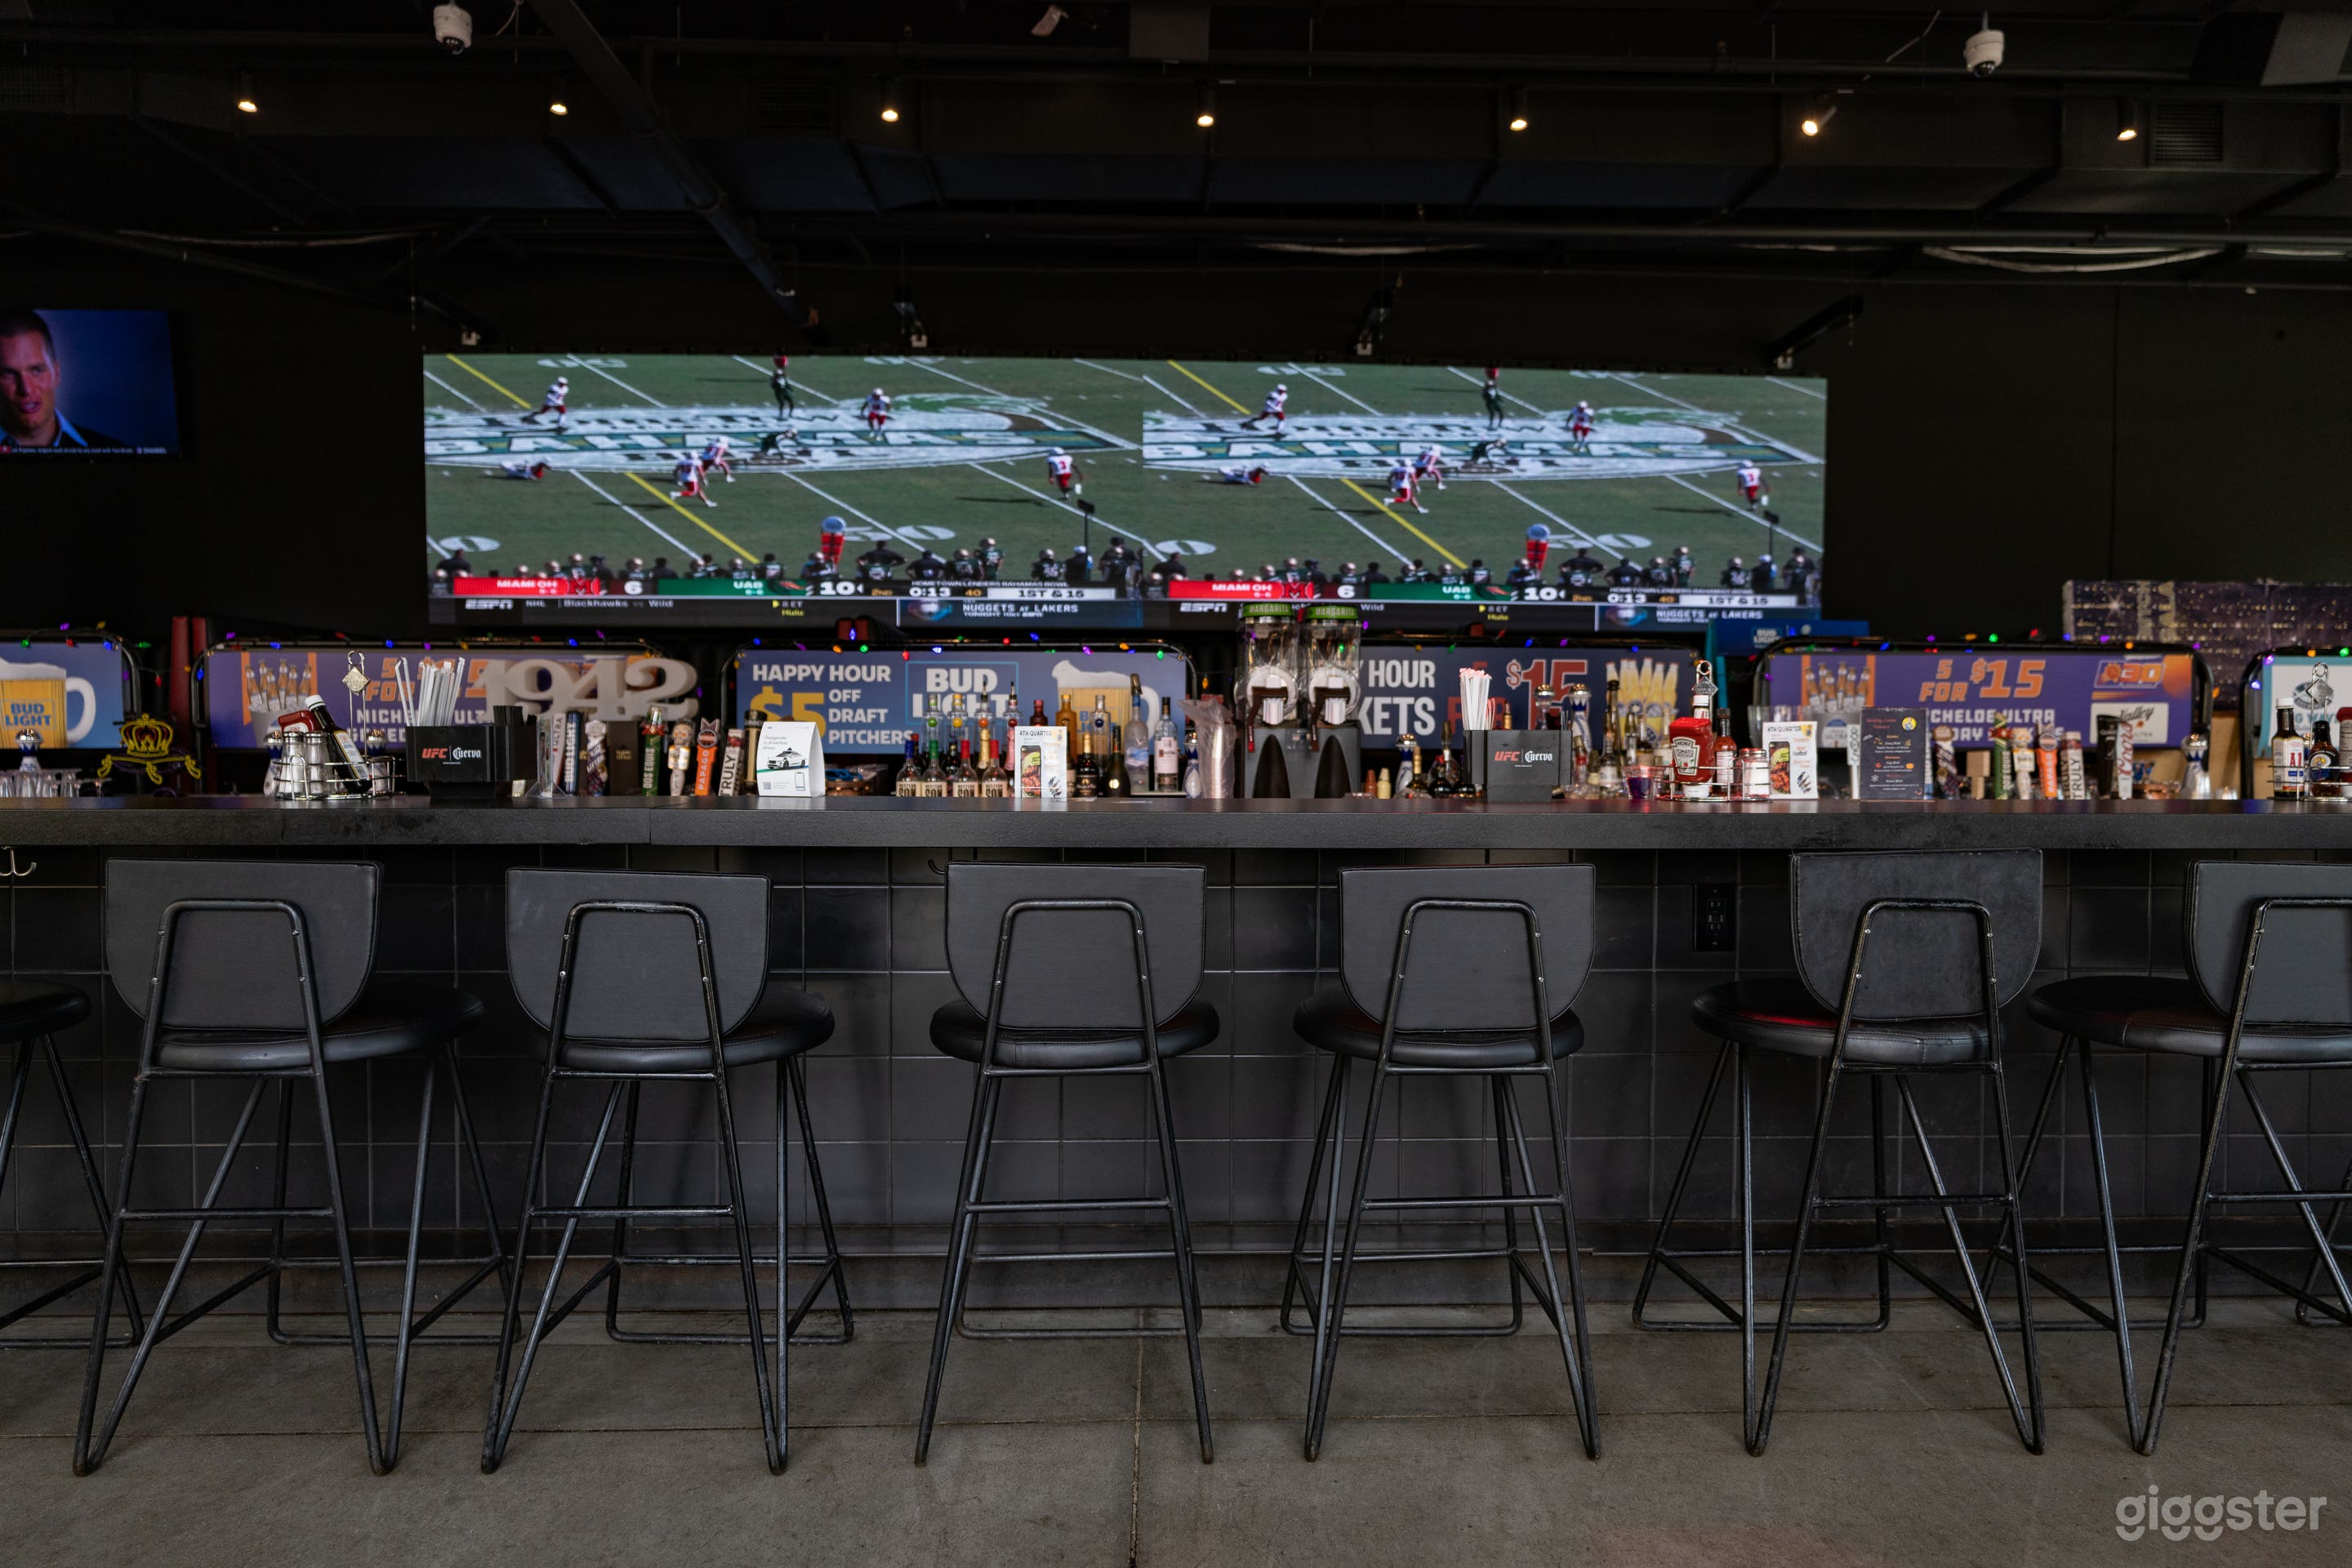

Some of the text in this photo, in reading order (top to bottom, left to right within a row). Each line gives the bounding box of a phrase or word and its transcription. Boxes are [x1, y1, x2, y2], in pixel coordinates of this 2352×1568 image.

[624, 581, 644, 595] 6
[820, 581, 855, 595] 10
[909, 587, 951, 597] 0:13
[964, 589, 982, 597] 40
[1337, 586, 1355, 599] 6
[1524, 587, 1558, 600] 10
[466, 599, 514, 609] ESPN
[1607, 594, 1647, 604] 0:13
[963, 604, 1015, 612] NUGGETS
[1034, 604, 1079, 613] LAKERS
[1179, 603, 1228, 612] ESPN
[1249, 604, 1289, 613] MARGARITA
[1316, 608, 1356, 617] MARGARITA
[1656, 610, 1705, 619] NUGGETS
[1722, 611, 1764, 619] LAKERS
[381, 657, 398, 679] 5
[753, 664, 891, 683] HAPPY HOUR
[1368, 660, 1436, 688] HOUR
[1936, 659, 1953, 679] 5
[926, 668, 998, 693] BUD
[1969, 657, 2046, 698] $15
[470, 658, 699, 724] 1942
[829, 689, 862, 703] OFF
[1506, 659, 1588, 730] $15
[1918, 682, 1968, 702] FOR
[11, 703, 45, 715] BUD
[750, 686, 826, 741] $5
[829, 708, 889, 724] DRAFT
[1357, 697, 1436, 735] KETS
[2001, 709, 2056, 724] ULTRA
[5, 715, 51, 726] LIGHT
[552, 717, 563, 747] ULTRA
[829, 729, 912, 746] PITCHERS
[421, 747, 482, 760] UFC Cuervo
[564, 723, 577, 782] BUD LIGHT
[1494, 751, 1553, 763] UFC Cuervo
[2117, 723, 2134, 776] Coors
[643, 748, 655, 788] DOS EQUIS
[2289, 752, 2302, 768] A1
[697, 751, 709, 790] PAPAGO
[719, 755, 737, 796] TRULY
[2044, 754, 2055, 793] PAPAGO
[2071, 758, 2083, 800] TRULY
